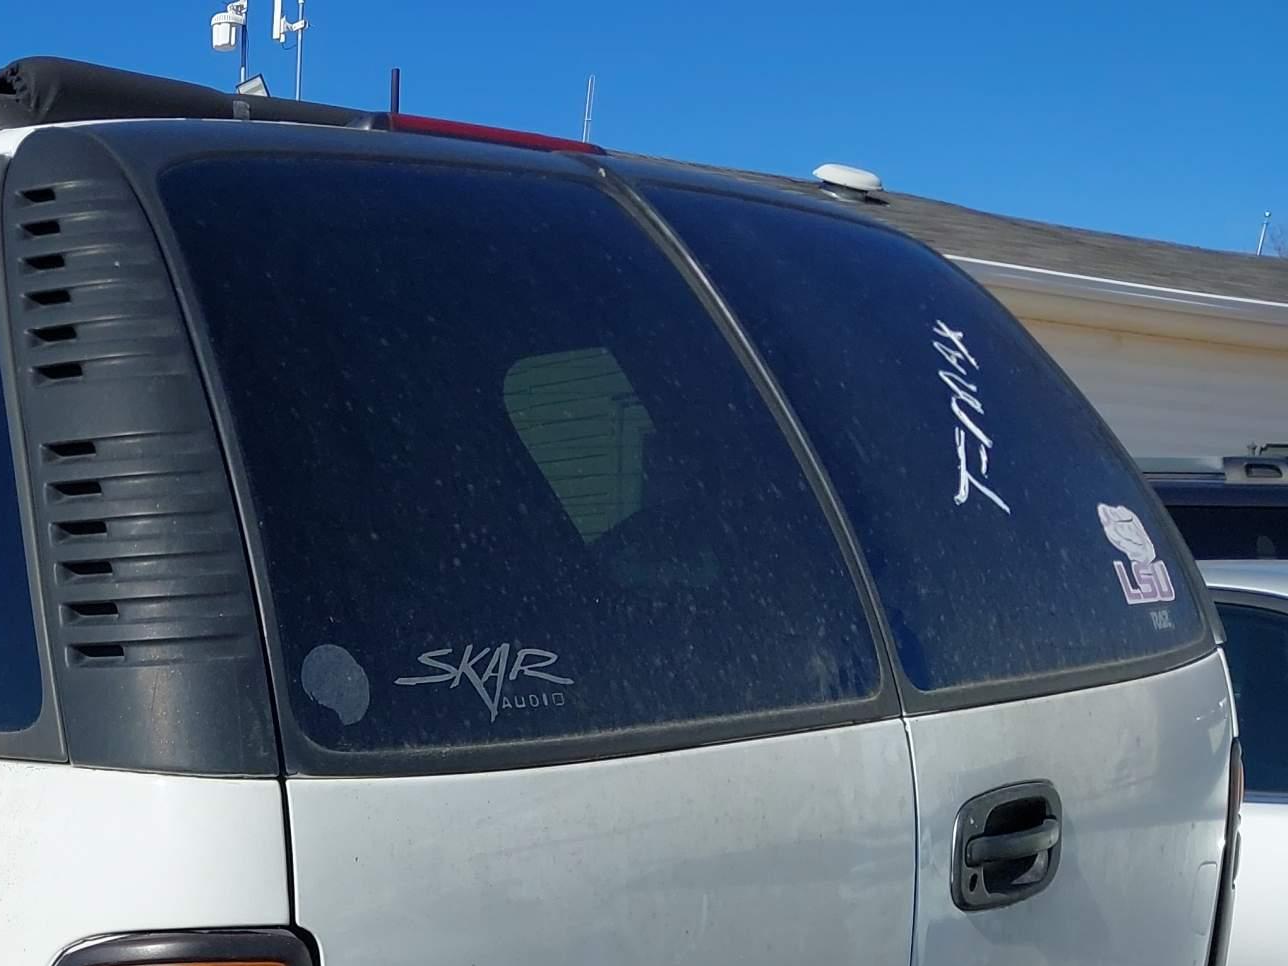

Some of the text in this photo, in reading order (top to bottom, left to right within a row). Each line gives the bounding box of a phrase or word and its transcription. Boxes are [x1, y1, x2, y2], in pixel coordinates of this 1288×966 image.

[1113, 560, 1176, 605] LSU
[393, 642, 575, 722] SKAR
[501, 692, 566, 709] AUDIO
